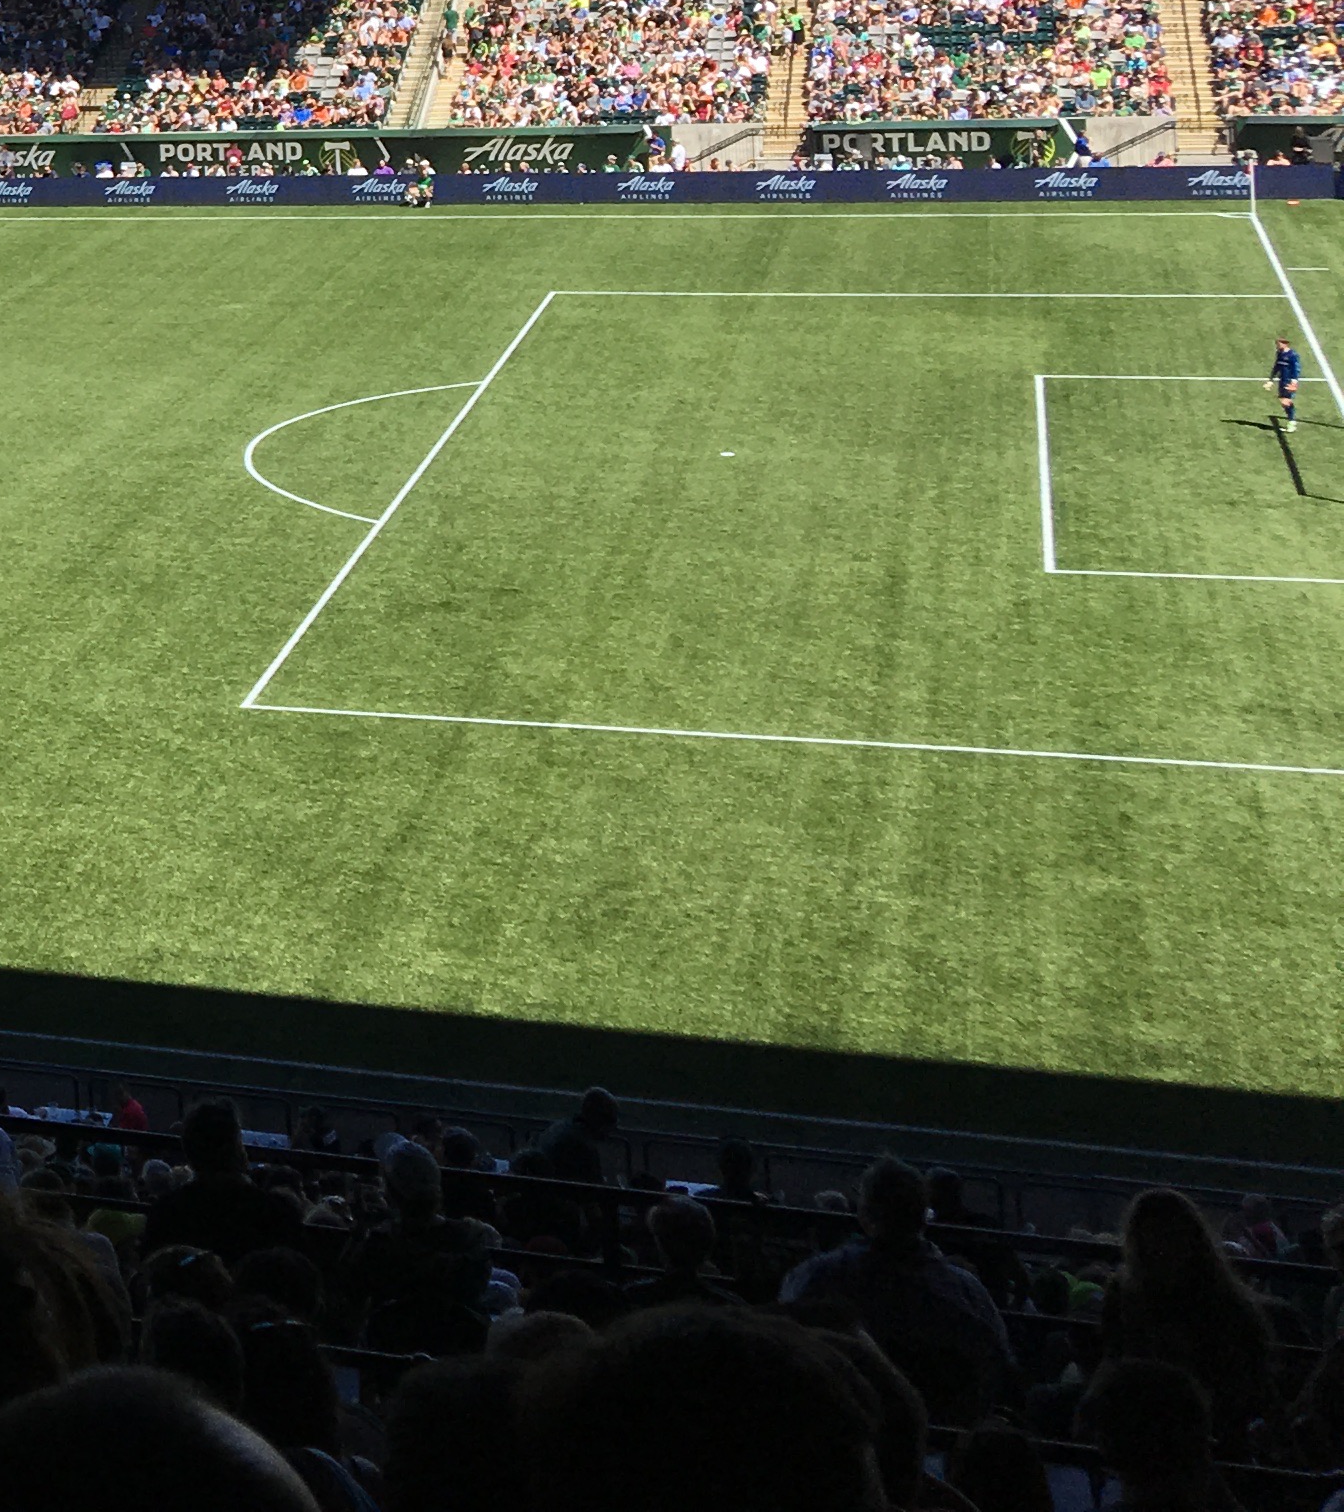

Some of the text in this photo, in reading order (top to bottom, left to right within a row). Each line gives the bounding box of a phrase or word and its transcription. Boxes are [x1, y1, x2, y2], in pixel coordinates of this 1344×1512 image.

[463, 137, 575, 165] Alaska
[105, 181, 156, 195] Alaska
[227, 180, 279, 194] Alaska
[352, 177, 406, 193] Alaska
[482, 176, 538, 193] Alaska
[617, 176, 675, 192] Alaska
[757, 175, 816, 191] Alaska
[887, 174, 948, 190] Alaska
[1035, 172, 1098, 189] Alaska
